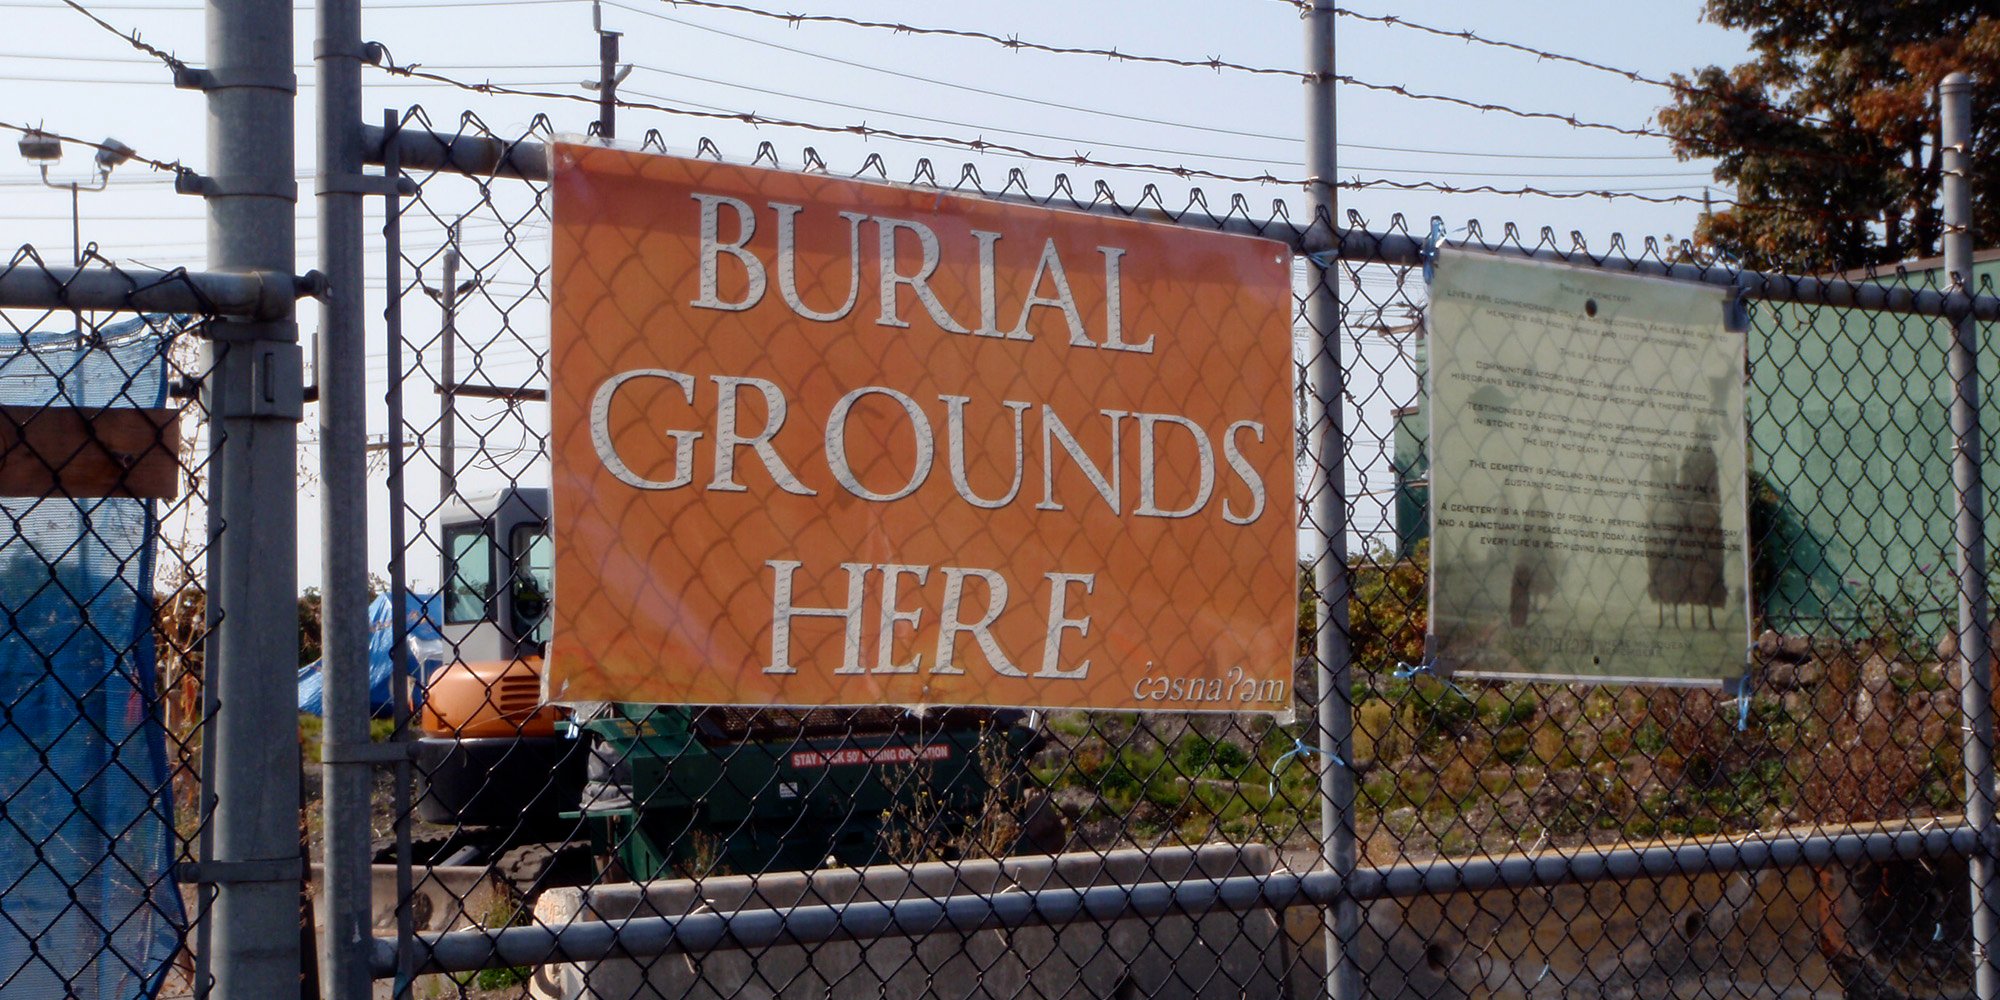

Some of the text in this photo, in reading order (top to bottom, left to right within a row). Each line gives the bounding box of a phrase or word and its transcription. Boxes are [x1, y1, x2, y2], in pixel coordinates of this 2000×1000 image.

[689, 192, 1155, 355] BURIAL
[1451, 372, 1503, 384] HISTORIANS
[1466, 401, 1523, 415] TESTIMONIES
[1486, 419, 1515, 432] STONE
[589, 368, 1266, 526] GROUNDS
[1469, 459, 1487, 469] THE
[1490, 462, 1534, 472] CEMETERY
[1441, 502, 1447, 510] A
[1450, 503, 1498, 513] CEMETERY
[1501, 507, 1510, 515] IS
[1521, 509, 1554, 518] HISTORY
[1437, 518, 1455, 528] AND
[1458, 519, 1465, 527] A
[1468, 520, 1521, 530] SANCTUARY
[1523, 523, 1534, 532] OF
[1537, 524, 1562, 535] PEACE
[1480, 536, 1509, 546] EVERY
[1511, 538, 1530, 546] LIFE
[1532, 540, 1541, 548] IS
[1597, 545, 1612, 554] AND
[762, 559, 1095, 680] HERE
[794, 753, 817, 767] STAY
